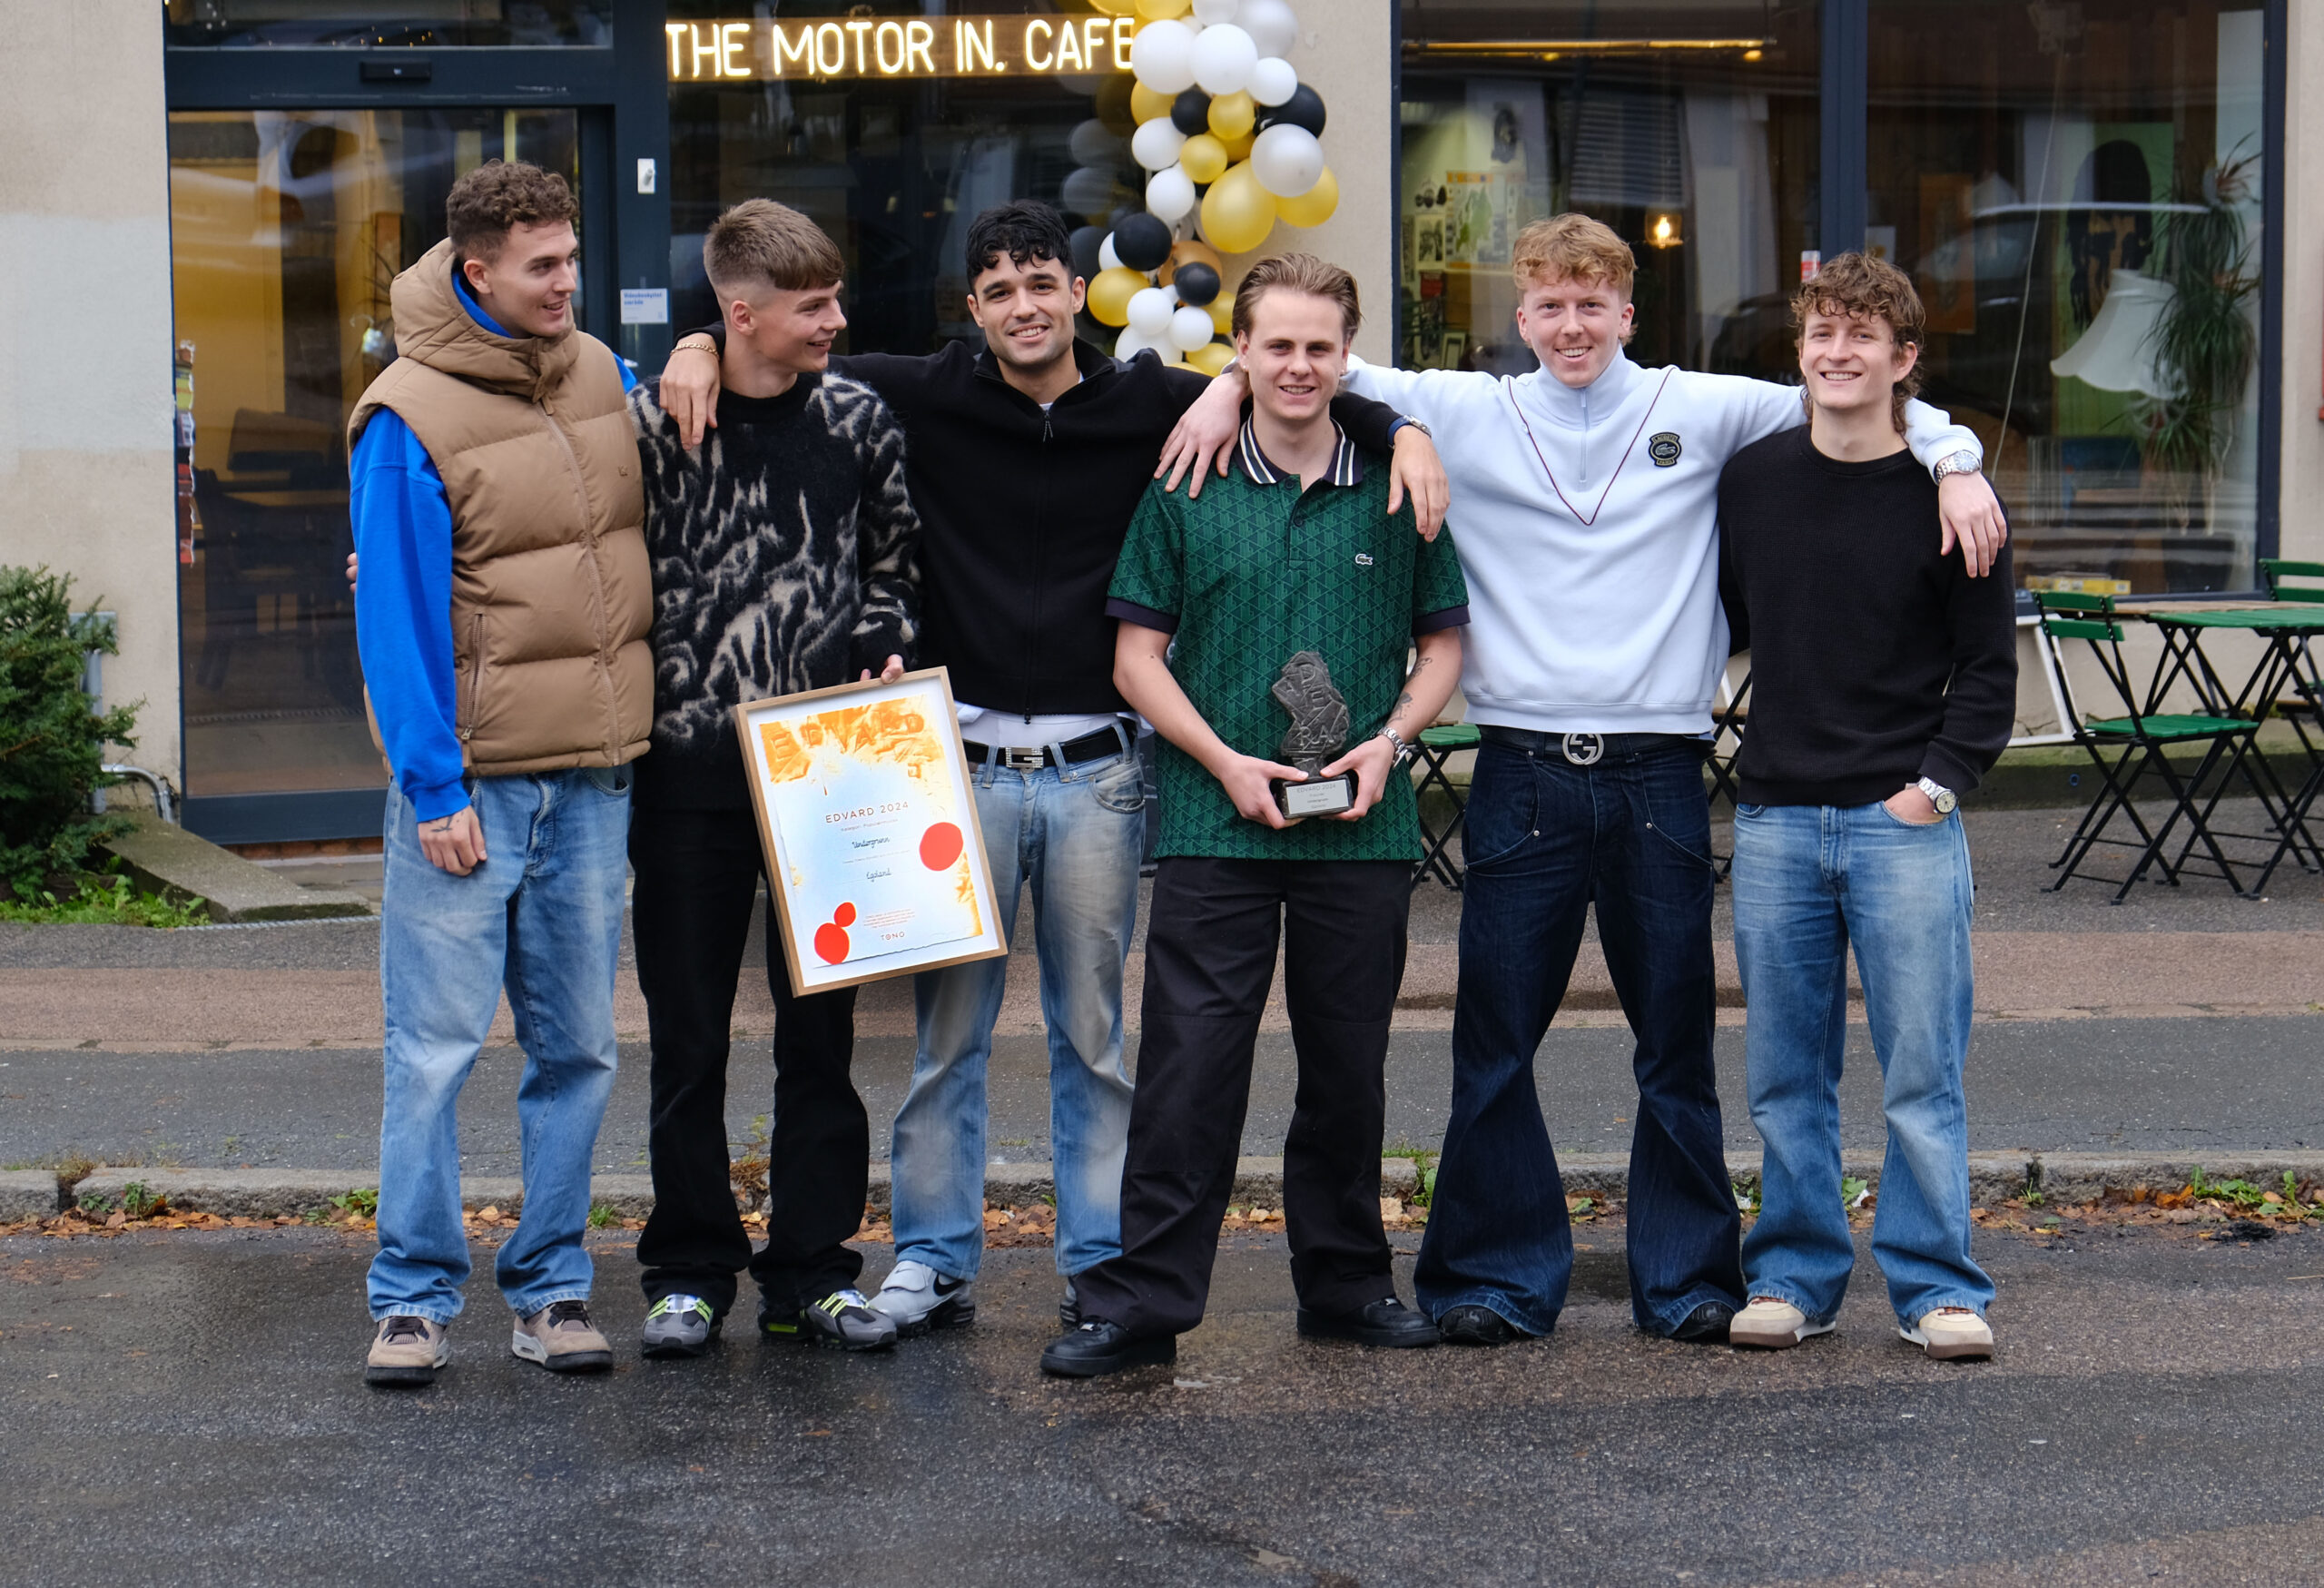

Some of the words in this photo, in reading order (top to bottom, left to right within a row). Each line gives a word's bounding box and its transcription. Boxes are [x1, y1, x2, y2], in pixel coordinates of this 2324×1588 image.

[665, 23, 751, 78] THE
[772, 21, 935, 77] MOTOR
[955, 18, 1008, 73] IN.
[1024, 16, 1135, 72] CAFE
[825, 807, 874, 824] EDVARD
[880, 801, 909, 814] 2024
